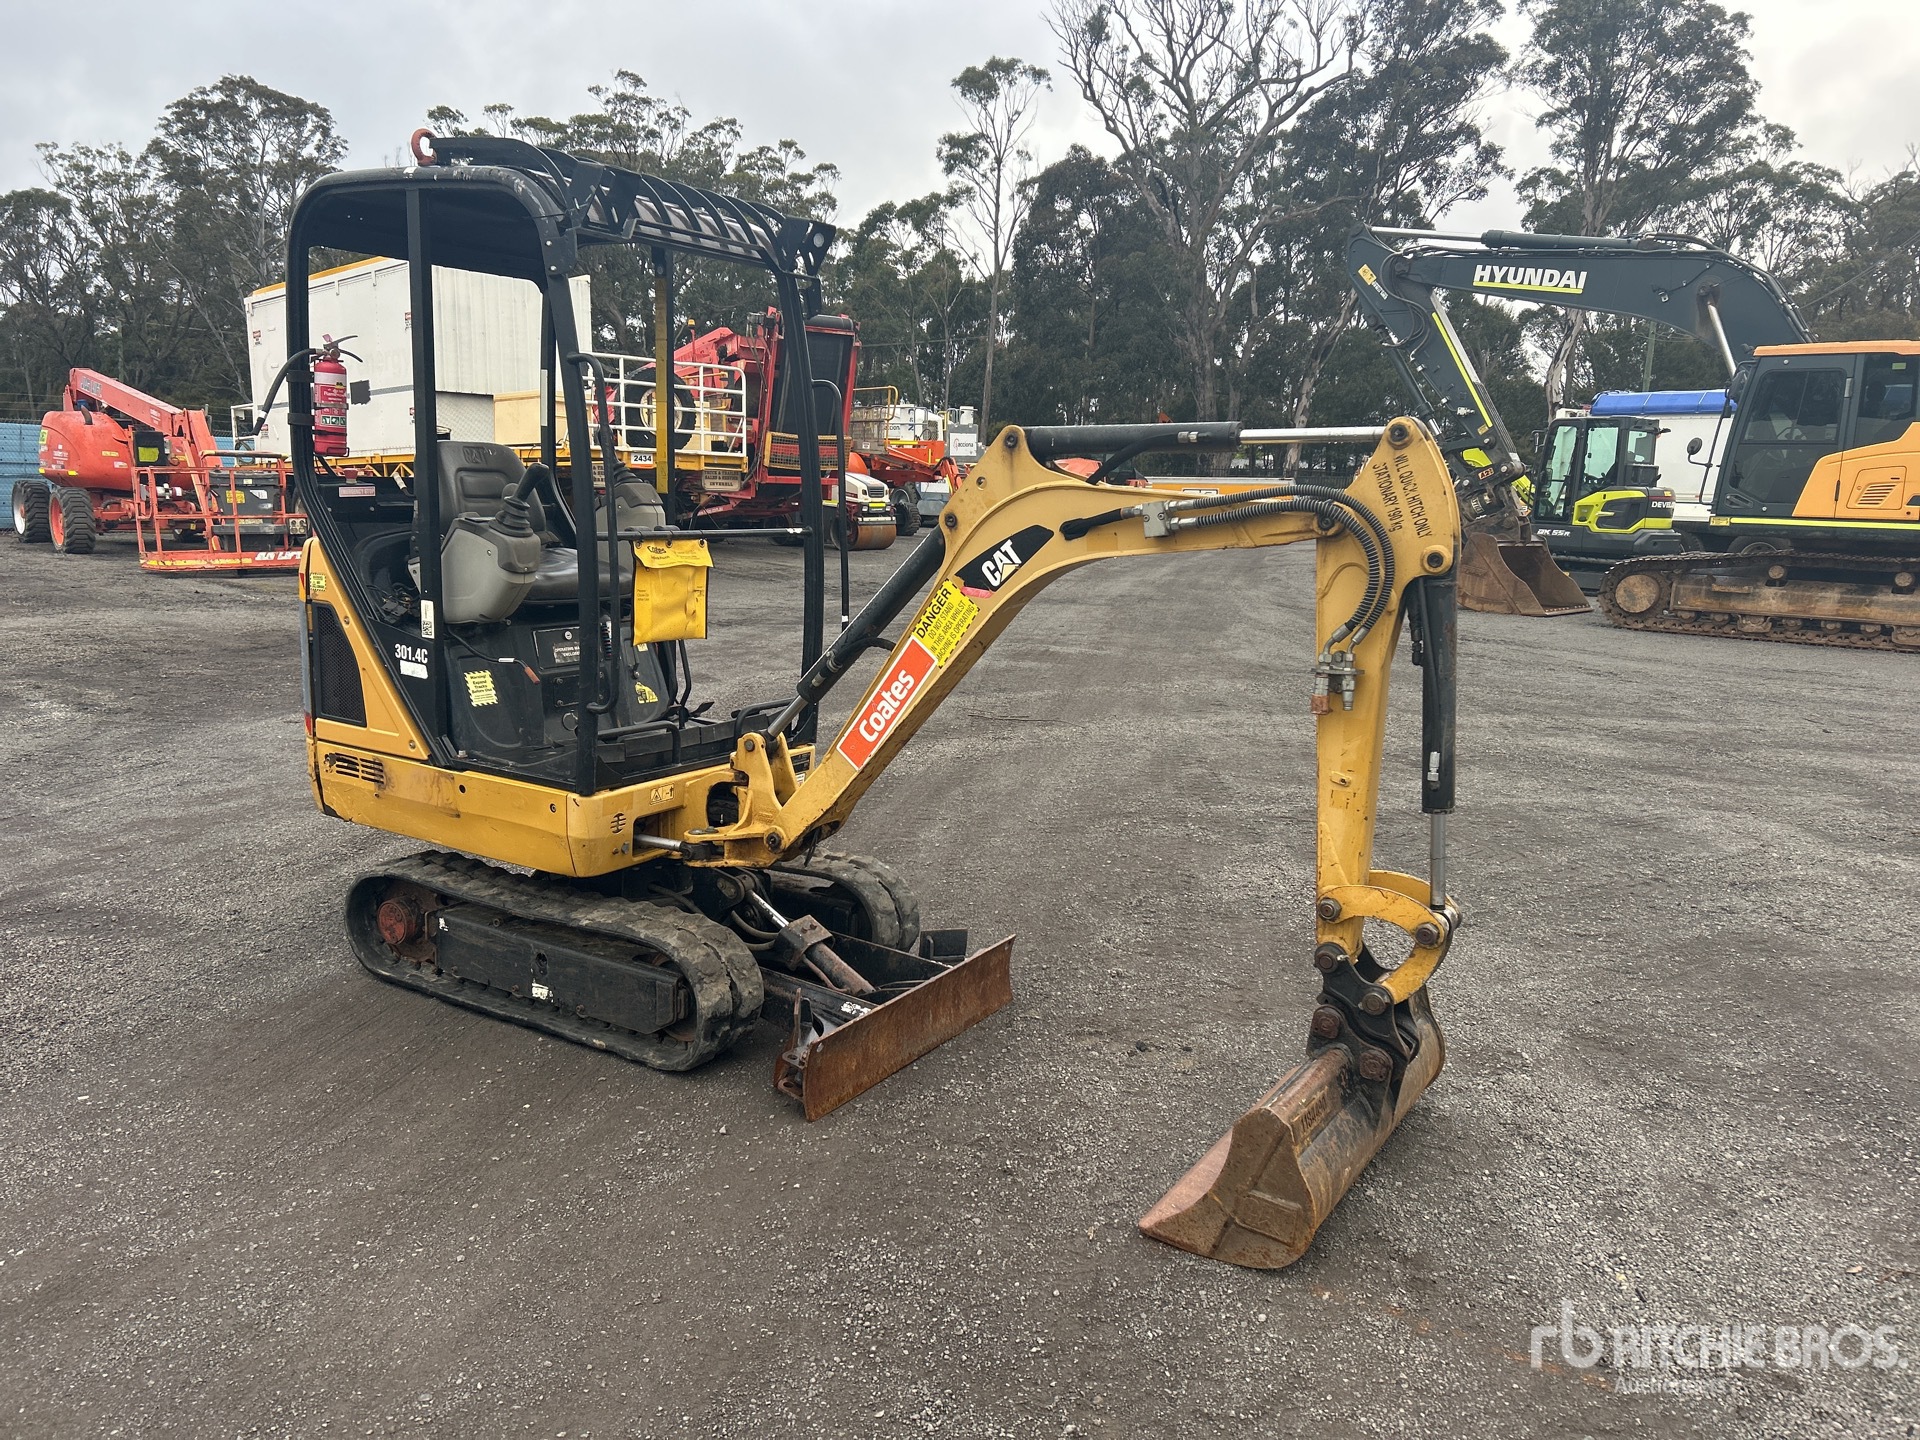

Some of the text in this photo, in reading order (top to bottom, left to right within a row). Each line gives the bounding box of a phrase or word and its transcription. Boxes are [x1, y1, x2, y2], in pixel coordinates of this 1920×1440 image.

[1475, 264, 1588, 289] HYUNDAI
[1372, 462, 1399, 507] STATIONARY
[1387, 507, 1404, 522] 190
[1406, 494, 1425, 519] HITCH
[1413, 517, 1432, 539] ONLY
[981, 538, 1022, 587] CAT
[916, 588, 952, 638] DANGER
[928, 602, 954, 639] DO NOT STAND
[934, 633, 945, 647] THIS
[942, 620, 954, 635] AREA
[950, 600, 967, 622] WHILST
[953, 604, 975, 634] OPERATING
[950, 631, 957, 640] IS
[394, 643, 428, 664] 301.4C
[858, 670, 915, 743] Coates
